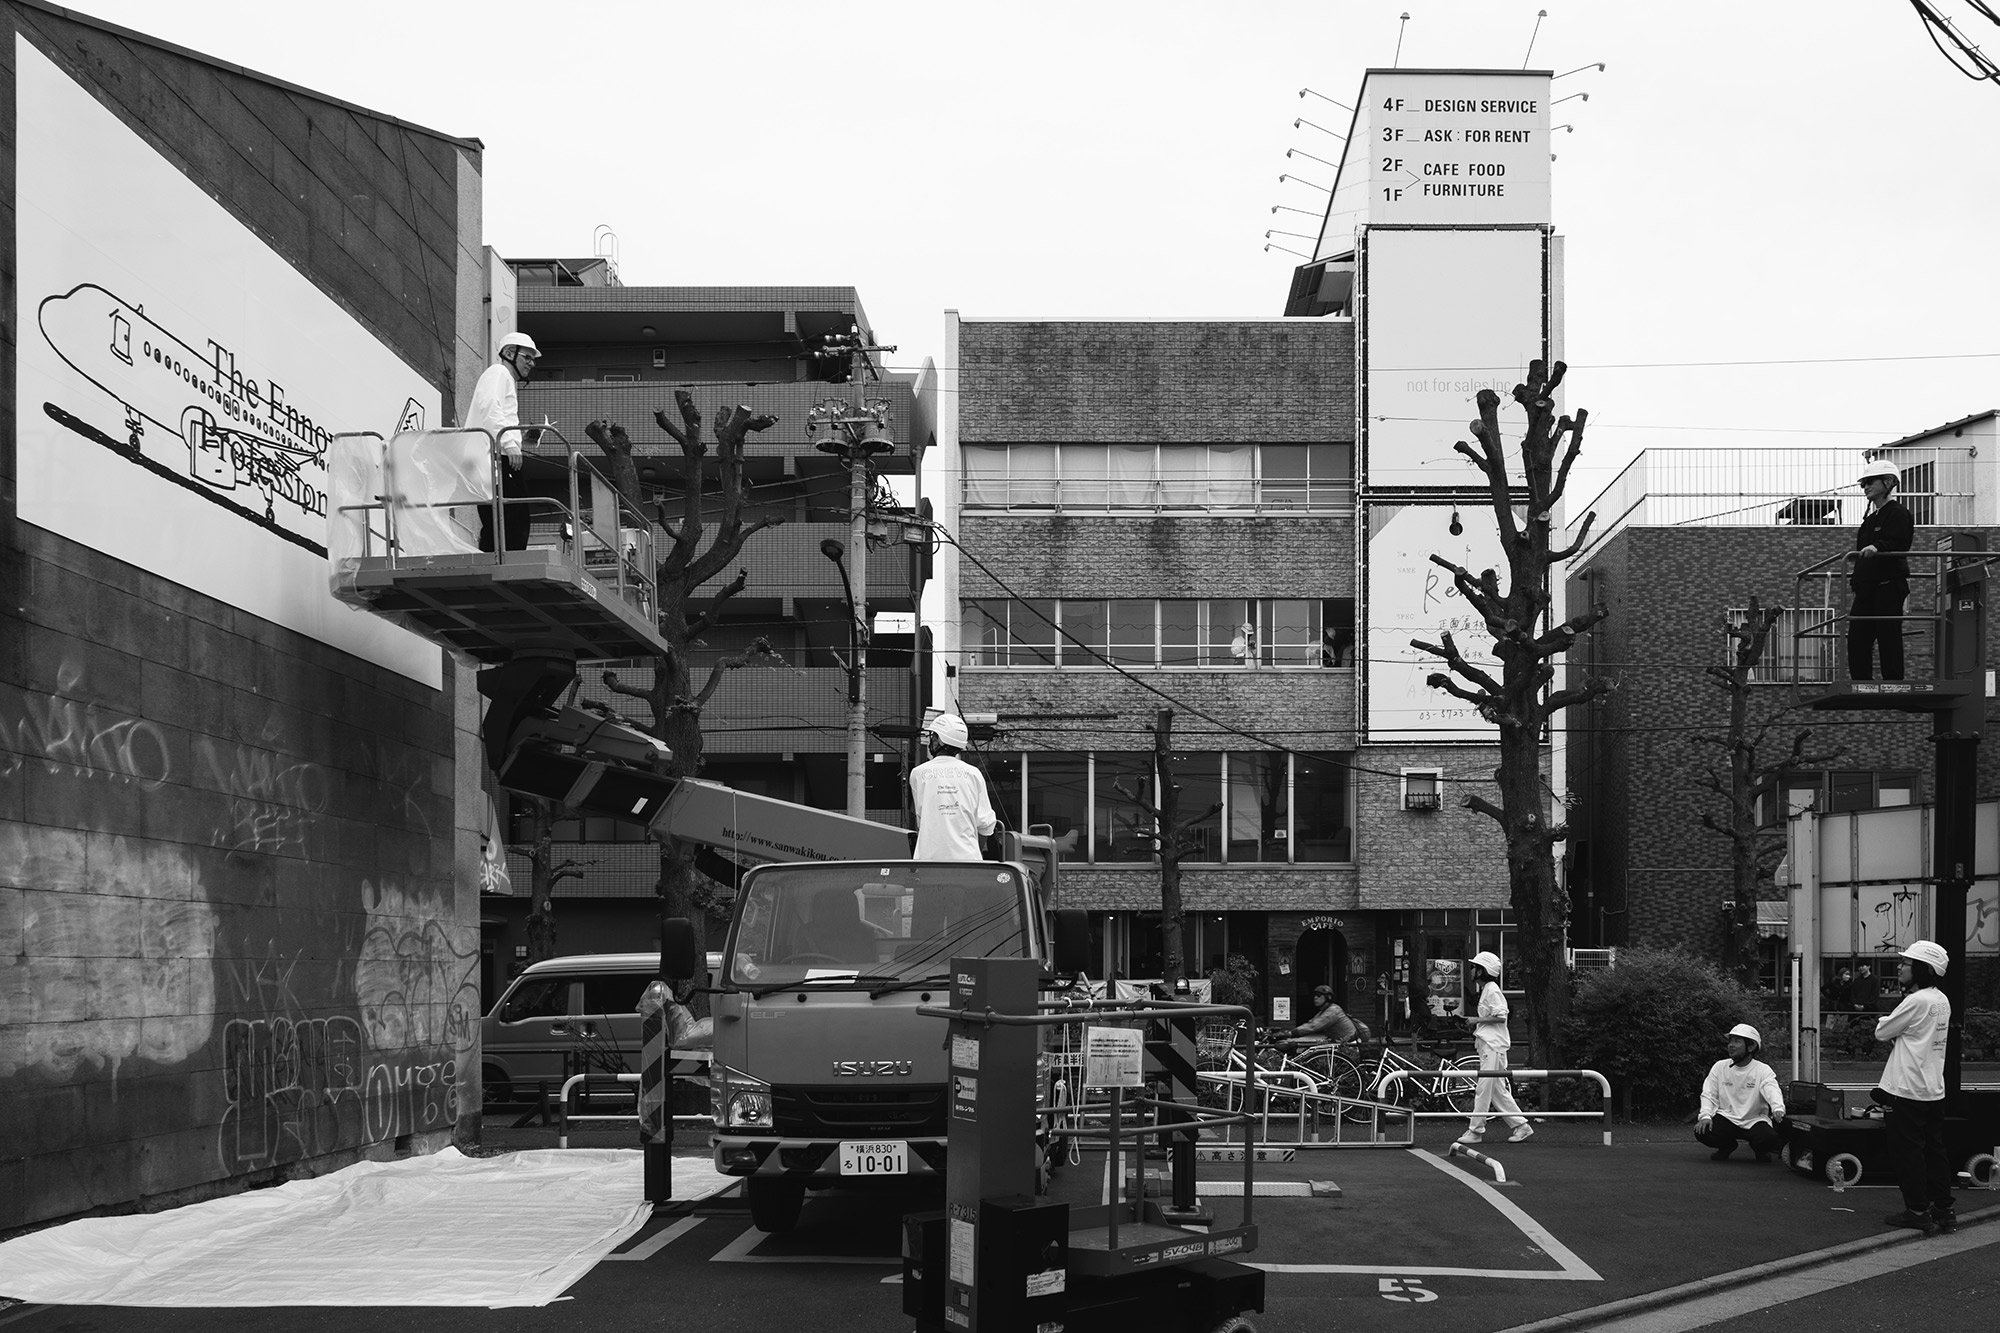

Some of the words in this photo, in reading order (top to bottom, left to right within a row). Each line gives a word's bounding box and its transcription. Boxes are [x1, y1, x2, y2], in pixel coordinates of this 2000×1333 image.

[1383, 97, 1405, 112] 4F
[1424, 99, 1476, 112] DESIGN
[1480, 99, 1537, 113] SERVICE
[1382, 127, 1405, 142] 3F
[1424, 129, 1454, 142] ASK
[1465, 130, 1491, 143] FOR
[1495, 130, 1531, 143] RENT
[1382, 157, 1404, 172] 2F
[1424, 163, 1460, 176] CAFE
[1469, 163, 1506, 176] FOOD
[1383, 187, 1403, 202] 1F
[1424, 184, 1504, 197] FURNITURE
[1407, 380, 1428, 392] not
[1433, 377, 1450, 392] for
[1454, 378, 1489, 392] sales
[207, 338, 259, 409] The
[267, 379, 333, 454] Enno
[1301, 915, 1344, 927] EMPORIO
[750, 1010, 787, 1020] ELF
[833, 1060, 912, 1077] ISUZU
[844, 1160, 853, 1169] る
[857, 1155, 901, 1172] 10-01
[1212, 1150, 1267, 1161] 高さ意
[1379, 1278, 1439, 1303] 5
